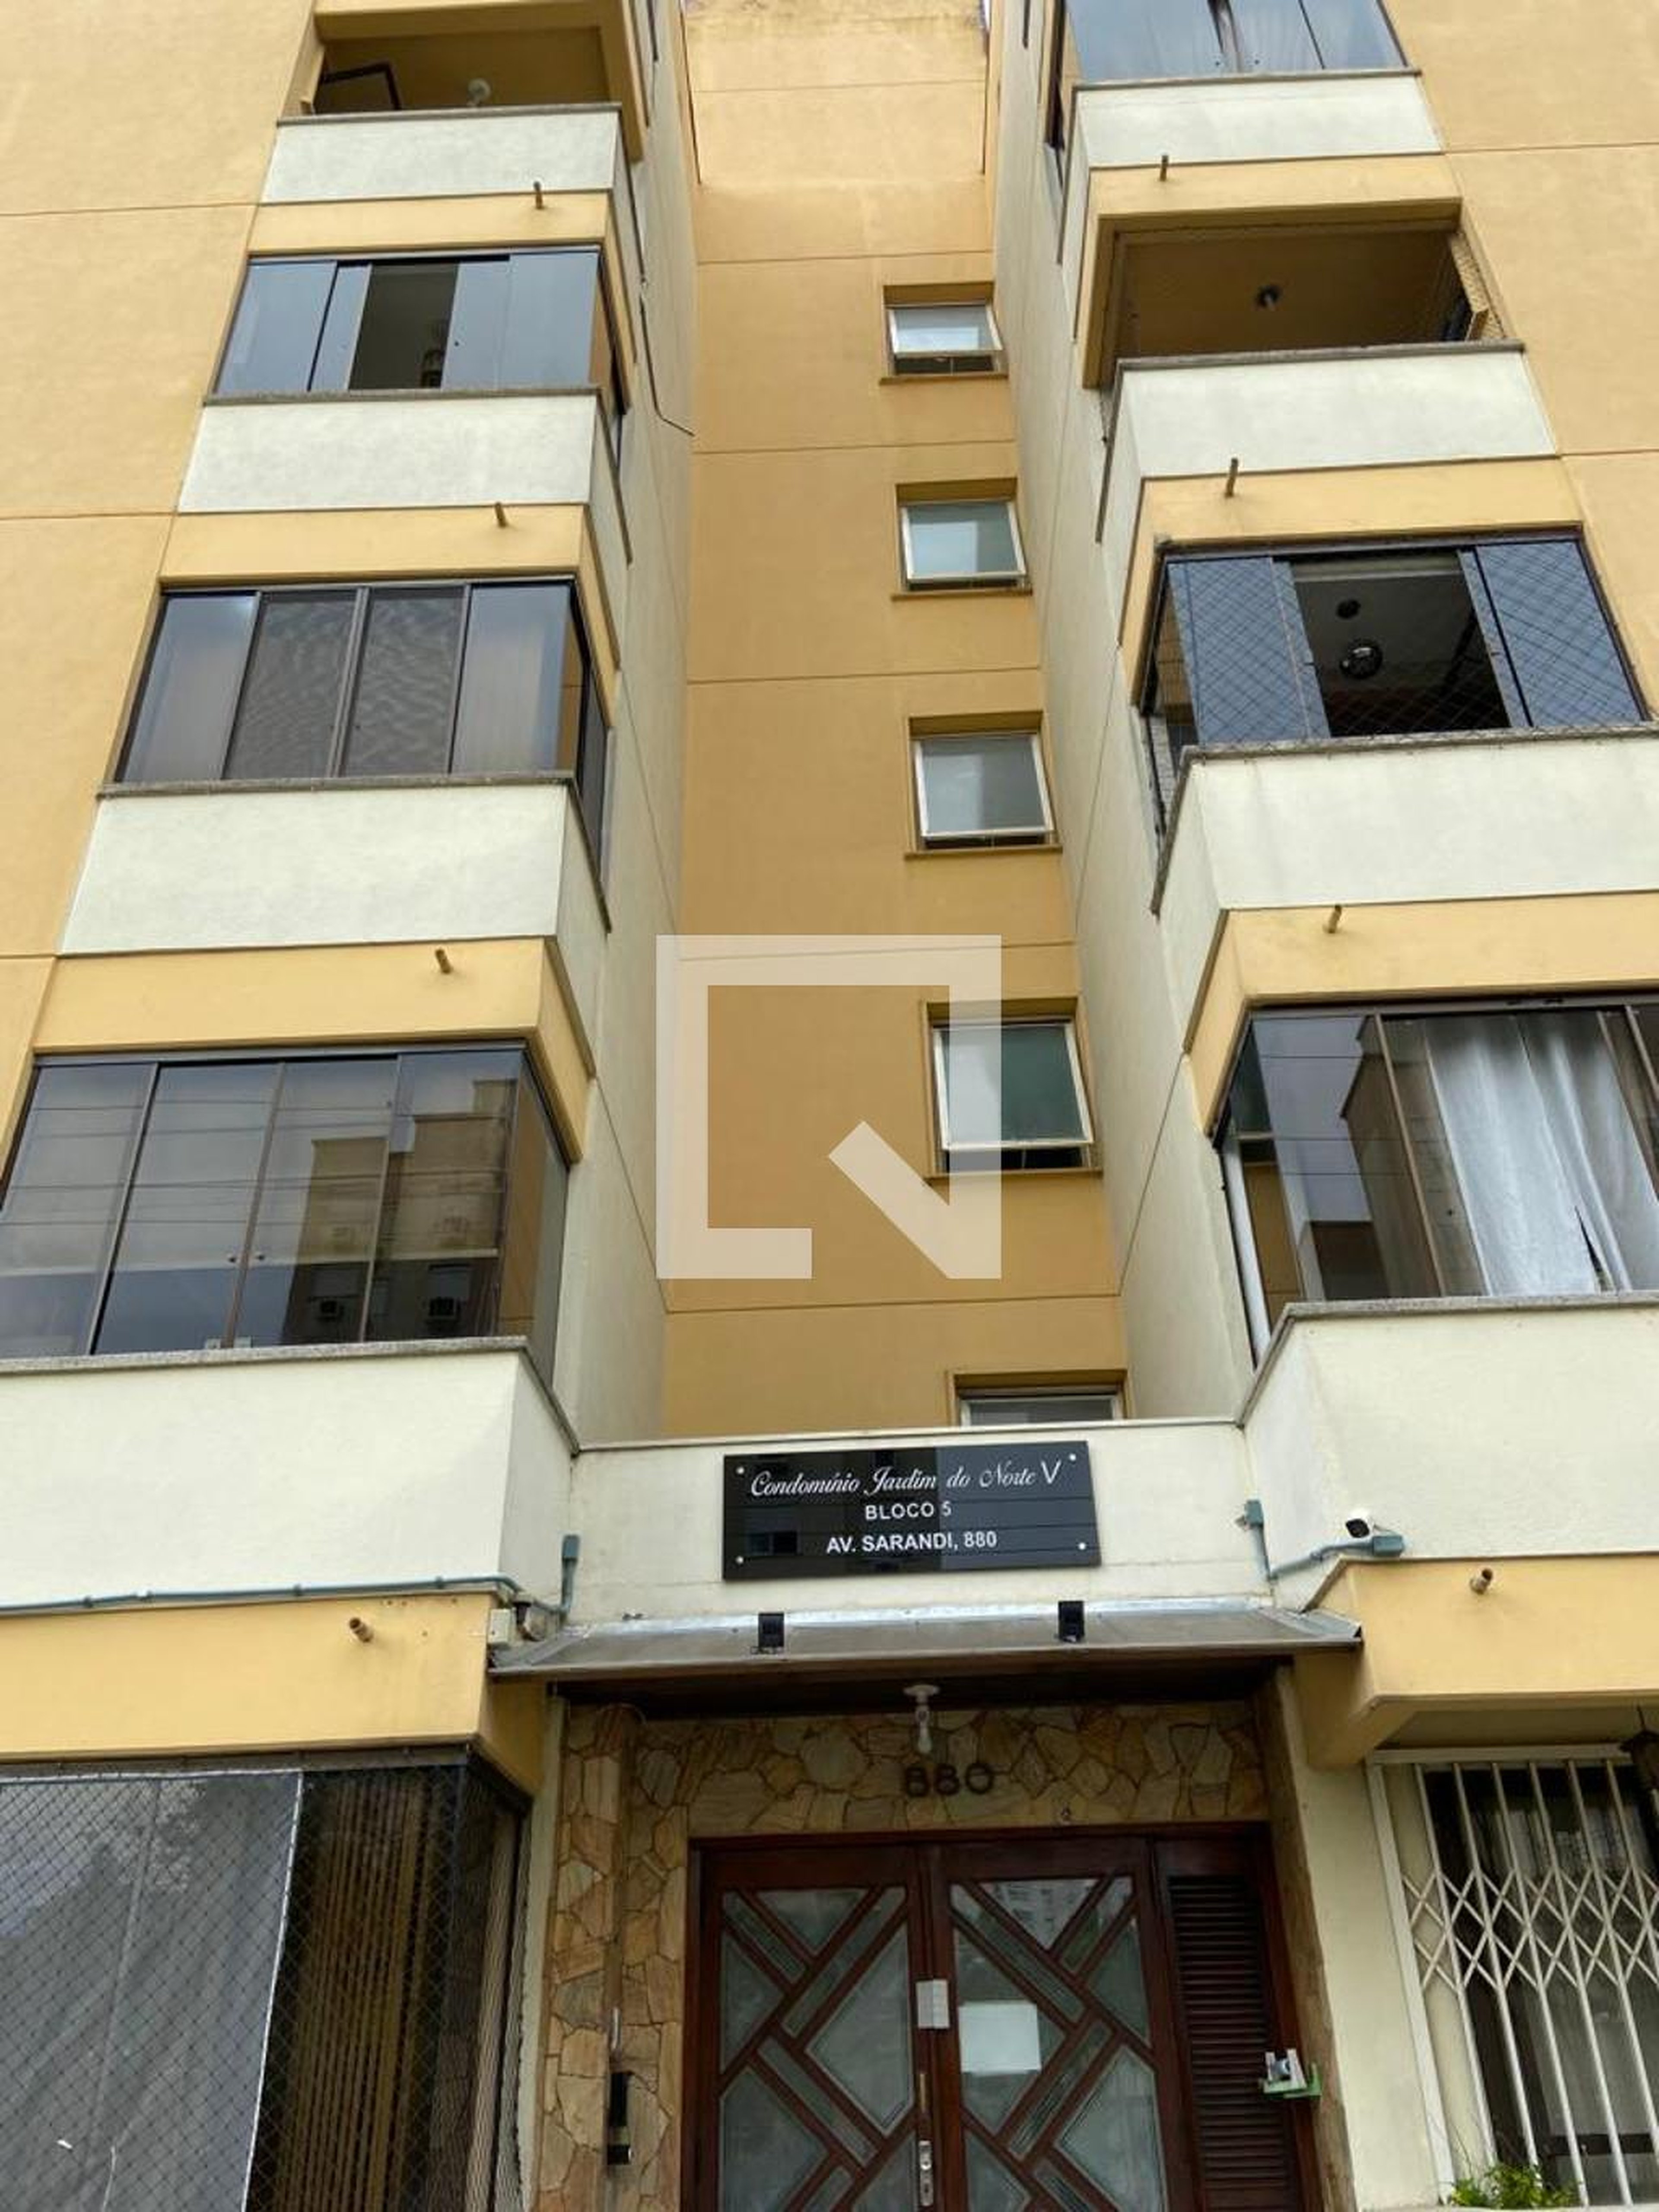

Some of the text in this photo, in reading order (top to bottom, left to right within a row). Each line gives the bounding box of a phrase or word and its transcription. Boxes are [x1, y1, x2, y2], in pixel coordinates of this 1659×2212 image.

[751, 1460, 1062, 1497] Condomínio Jardim do Norte V
[865, 1500, 952, 1520] BLOCO 5
[826, 1530, 998, 1554] AV. SARANDI, 880
[905, 1762, 994, 1798] 880
